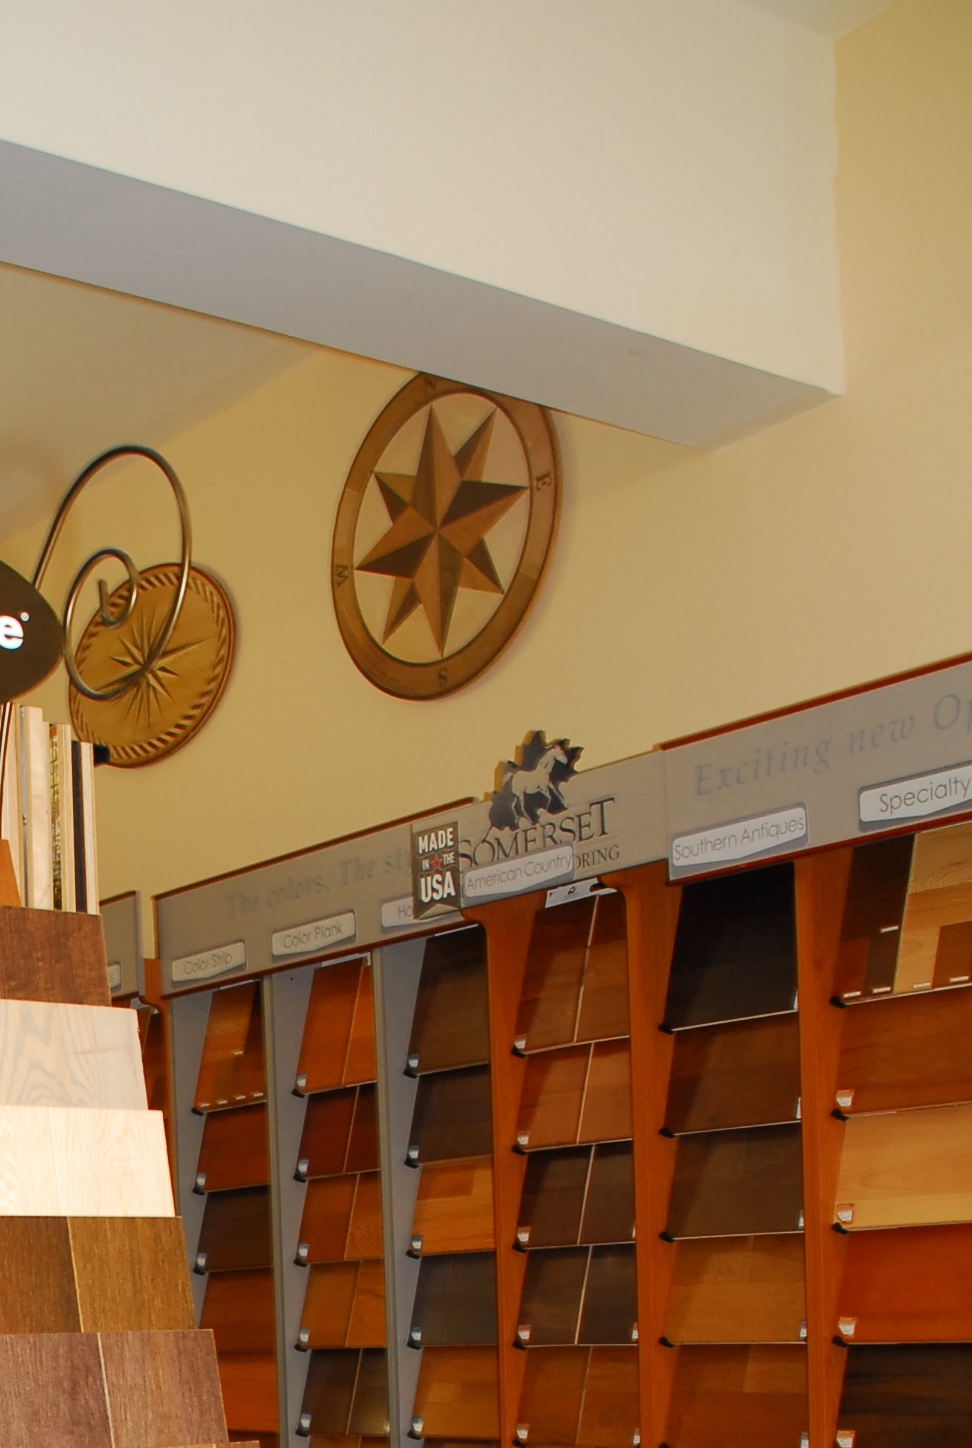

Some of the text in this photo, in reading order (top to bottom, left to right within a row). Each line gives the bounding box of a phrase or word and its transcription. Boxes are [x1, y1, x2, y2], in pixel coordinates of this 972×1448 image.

[695, 738, 832, 797] Exciting
[848, 714, 916, 754] new
[879, 776, 972, 816] Specialty
[417, 827, 454, 854] MADE
[459, 797, 617, 868] SOMERSET
[673, 816, 805, 861] Southern Antiques
[422, 851, 456, 871] IN THE
[466, 852, 574, 891] American Country
[420, 870, 457, 903] USA
[283, 920, 345, 950] Color Plank
[183, 950, 234, 976] Color Strip
